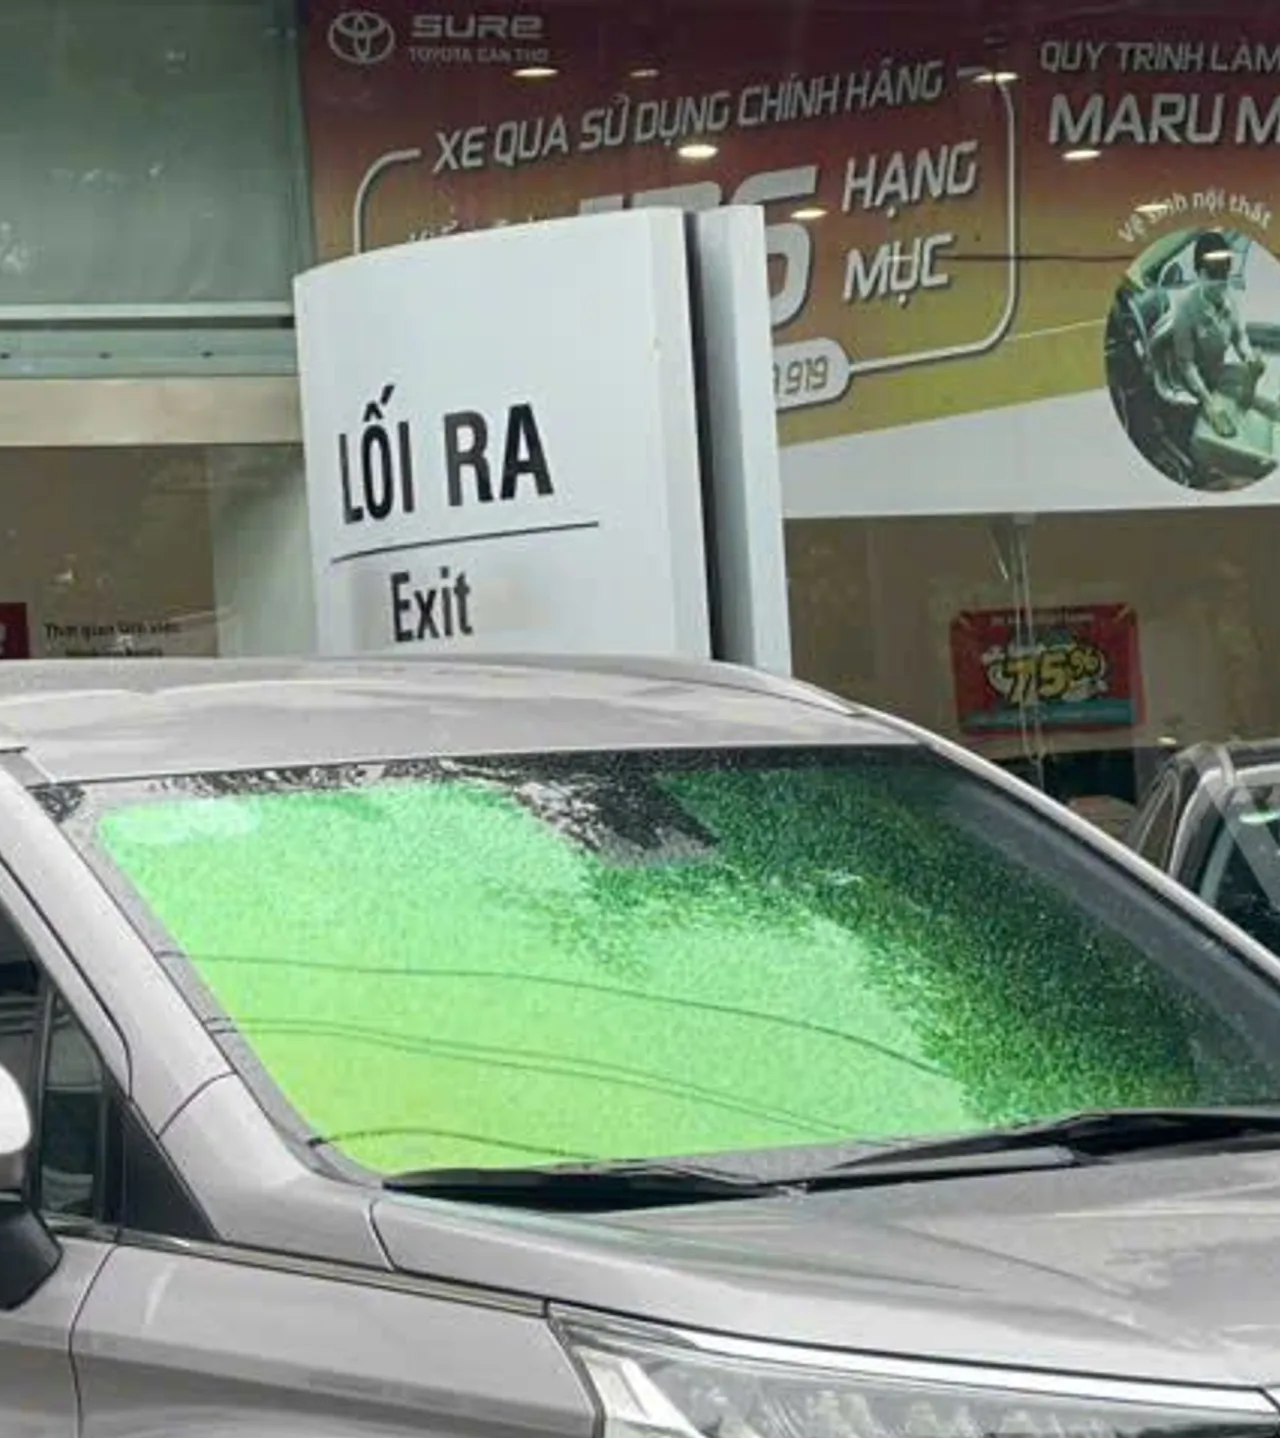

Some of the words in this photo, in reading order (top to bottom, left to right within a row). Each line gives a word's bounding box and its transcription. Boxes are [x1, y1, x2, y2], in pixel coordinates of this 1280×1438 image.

[1040, 40, 1106, 73] QUY
[433, 125, 487, 173] XE
[494, 114, 569, 166] QUA
[634, 89, 730, 146] DỤNG
[737, 72, 839, 127] CHÍNH
[844, 58, 942, 110] HÃNG
[1048, 93, 1224, 145] MARU
[842, 139, 978, 218] HẠNG
[843, 233, 953, 305] MỤC
[338, 383, 414, 525] LỐI
[444, 402, 554, 507] RA
[391, 566, 474, 643] Exit
